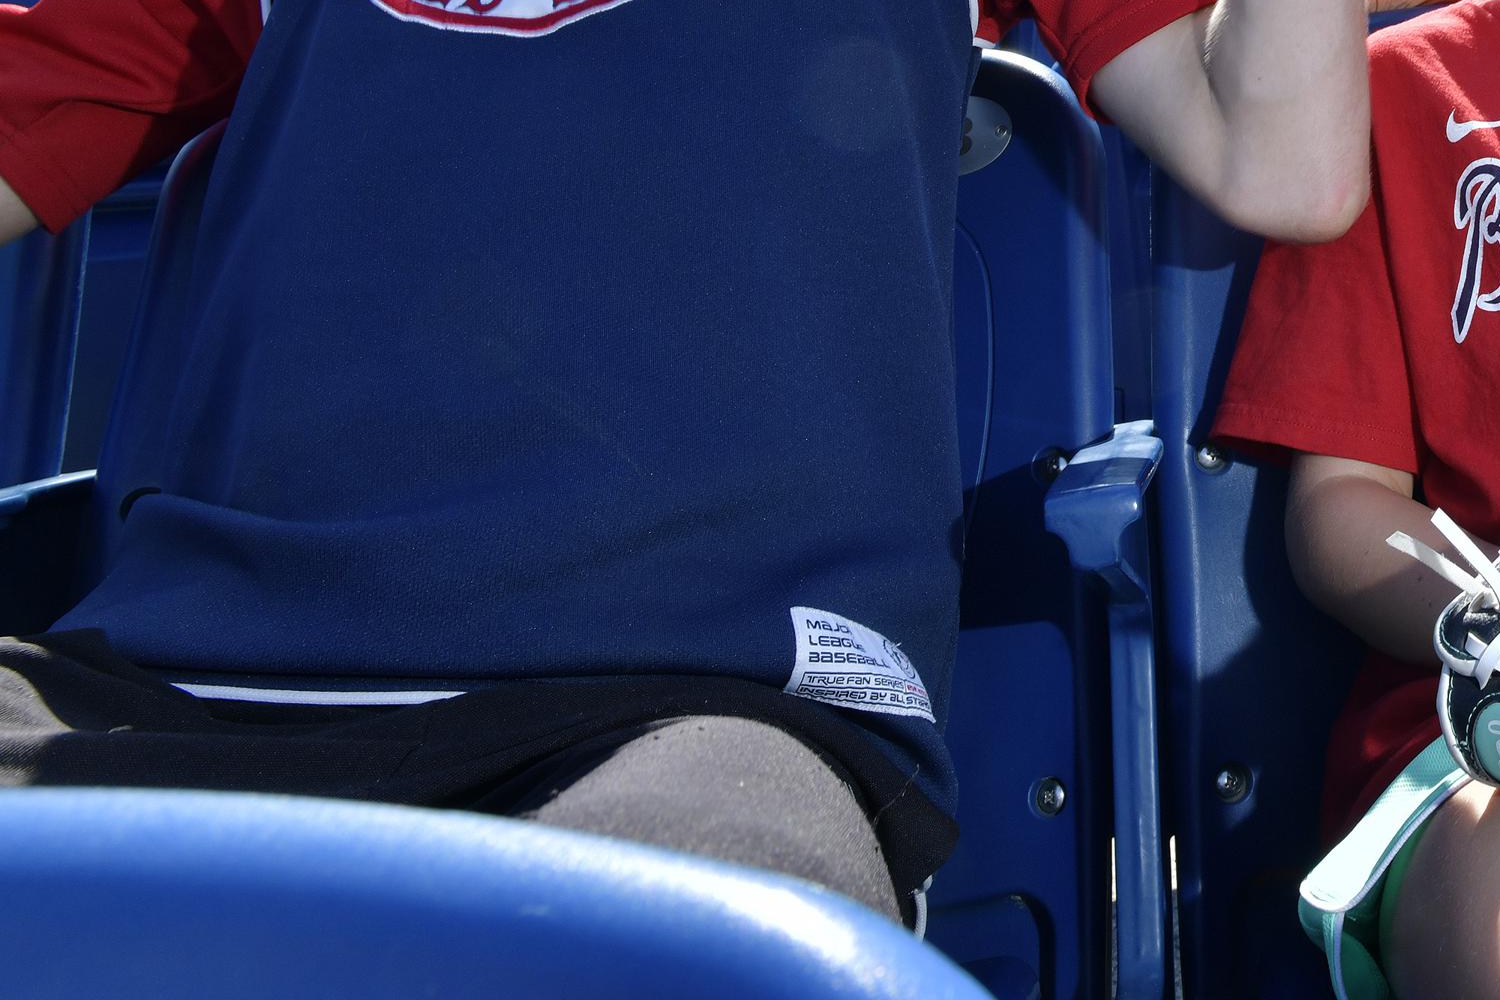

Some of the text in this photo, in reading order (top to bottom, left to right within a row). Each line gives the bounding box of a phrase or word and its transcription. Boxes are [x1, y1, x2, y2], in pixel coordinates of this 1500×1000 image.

[808, 651, 891, 668] BASEBALL
[806, 675, 845, 685] TRUE
[846, 675, 871, 685] FAN
[800, 687, 867, 700] INSPIRED
[869, 691, 888, 701] BY
